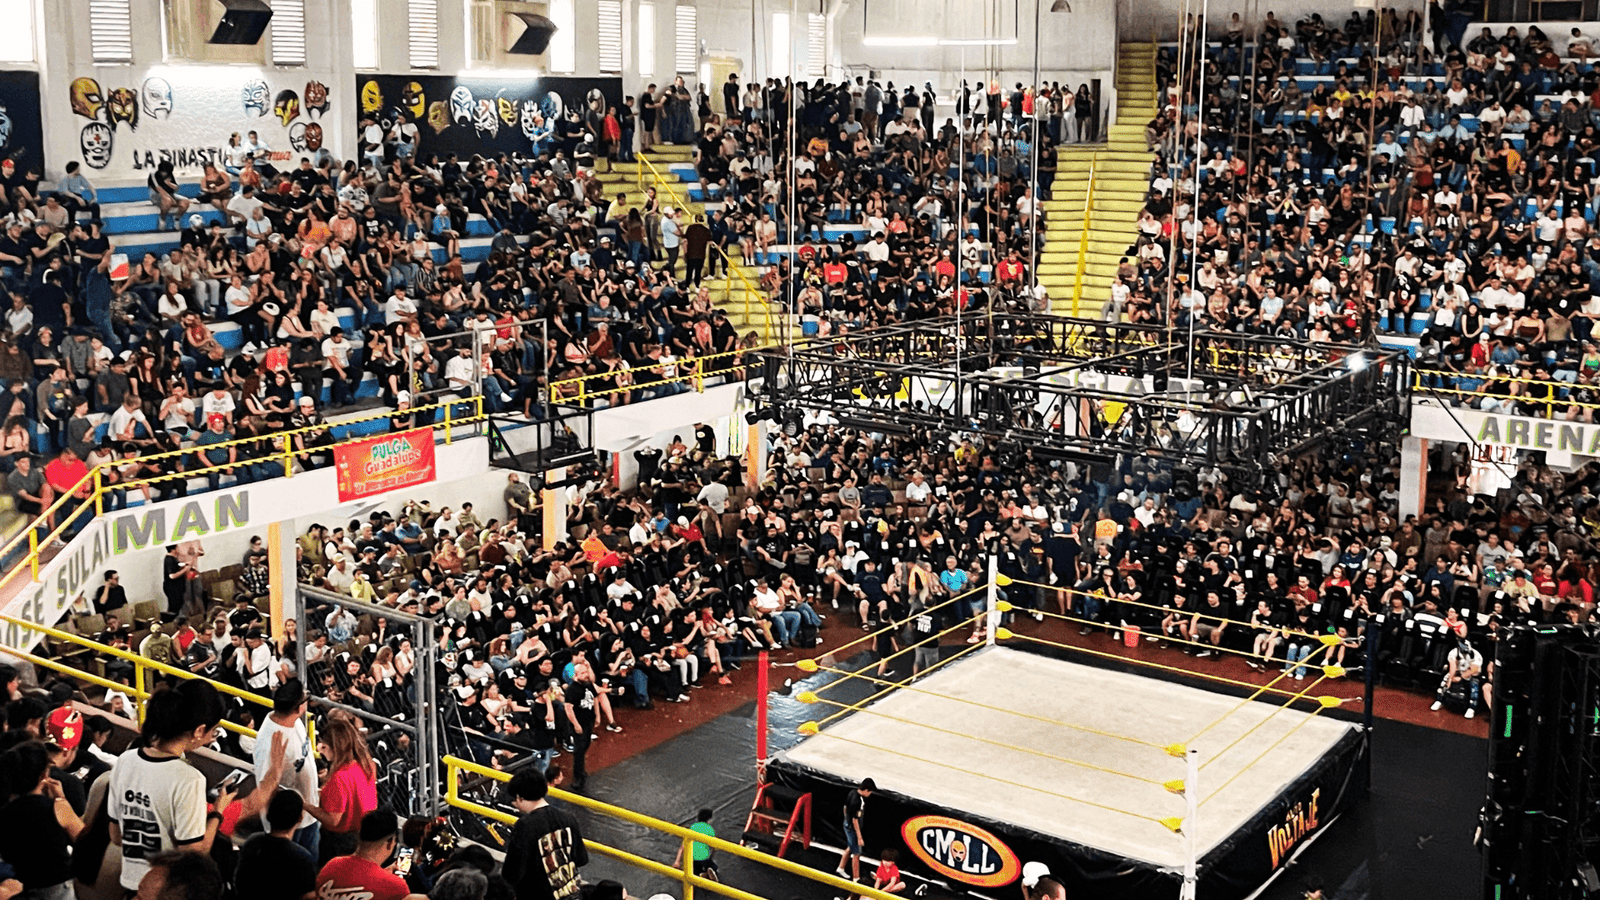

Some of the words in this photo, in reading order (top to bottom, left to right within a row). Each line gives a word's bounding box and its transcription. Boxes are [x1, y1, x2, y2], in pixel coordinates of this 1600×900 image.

[133, 149, 155, 170] LA
[371, 436, 412, 460] PULGA
[1267, 787, 1320, 871] VOLTAJE
[922, 828, 995, 874] CMLL
